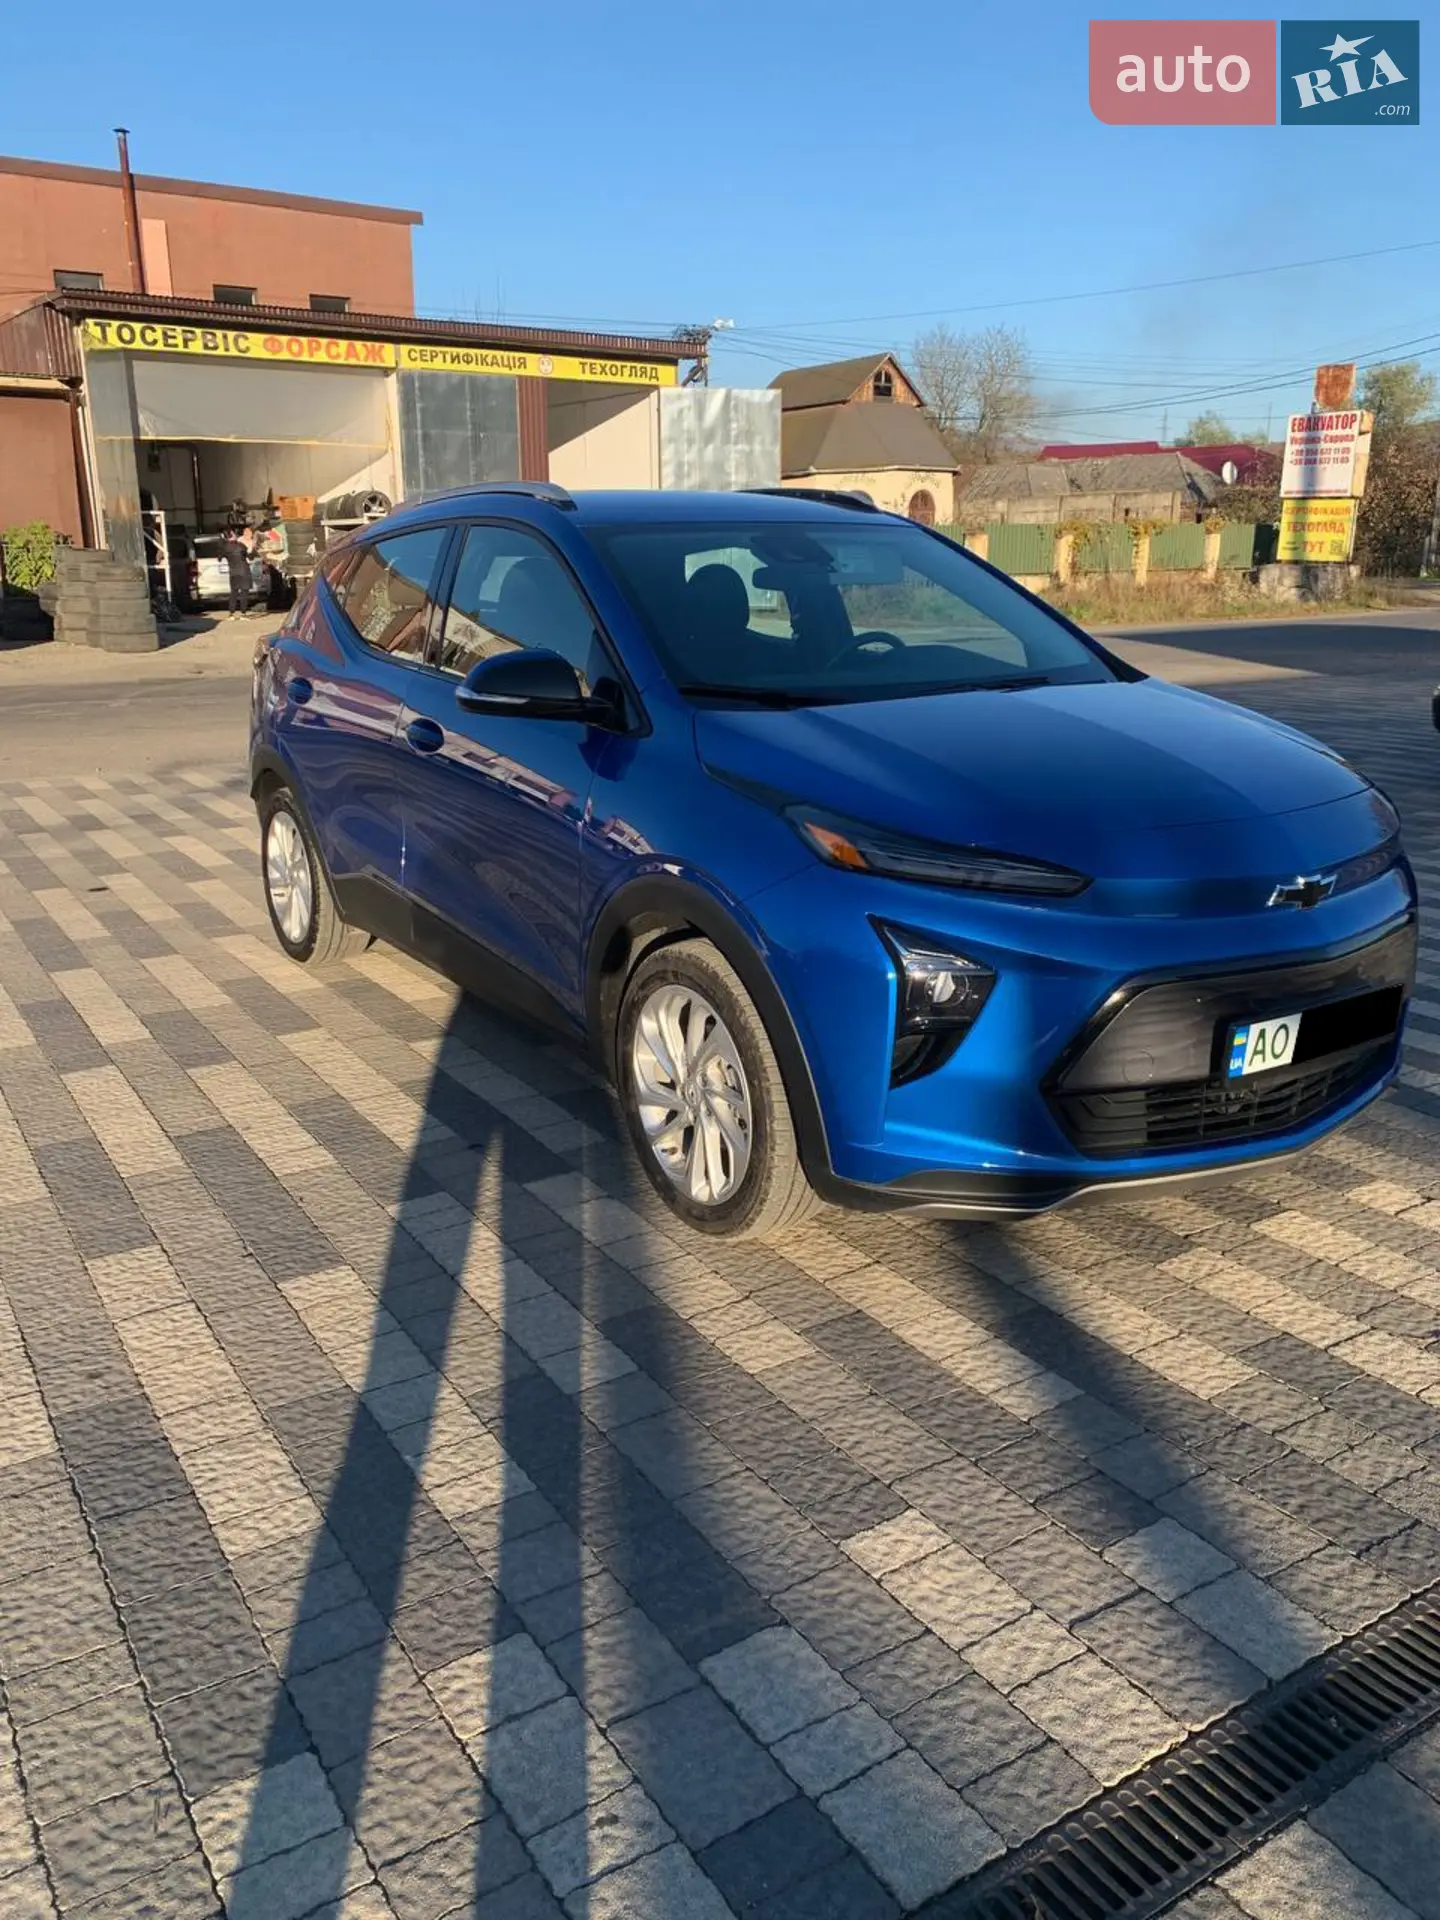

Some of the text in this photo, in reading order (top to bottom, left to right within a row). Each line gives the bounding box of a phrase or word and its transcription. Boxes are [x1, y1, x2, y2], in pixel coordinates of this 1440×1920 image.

[263, 335, 386, 364] ФОРСАЖ
[407, 347, 660, 382] СЕРТИФІКАЦІЯ ТЕХОГЛЯД
[1290, 413, 1357, 433] ЕВАКУАТОР
[1229, 1057, 1243, 1071] UA
